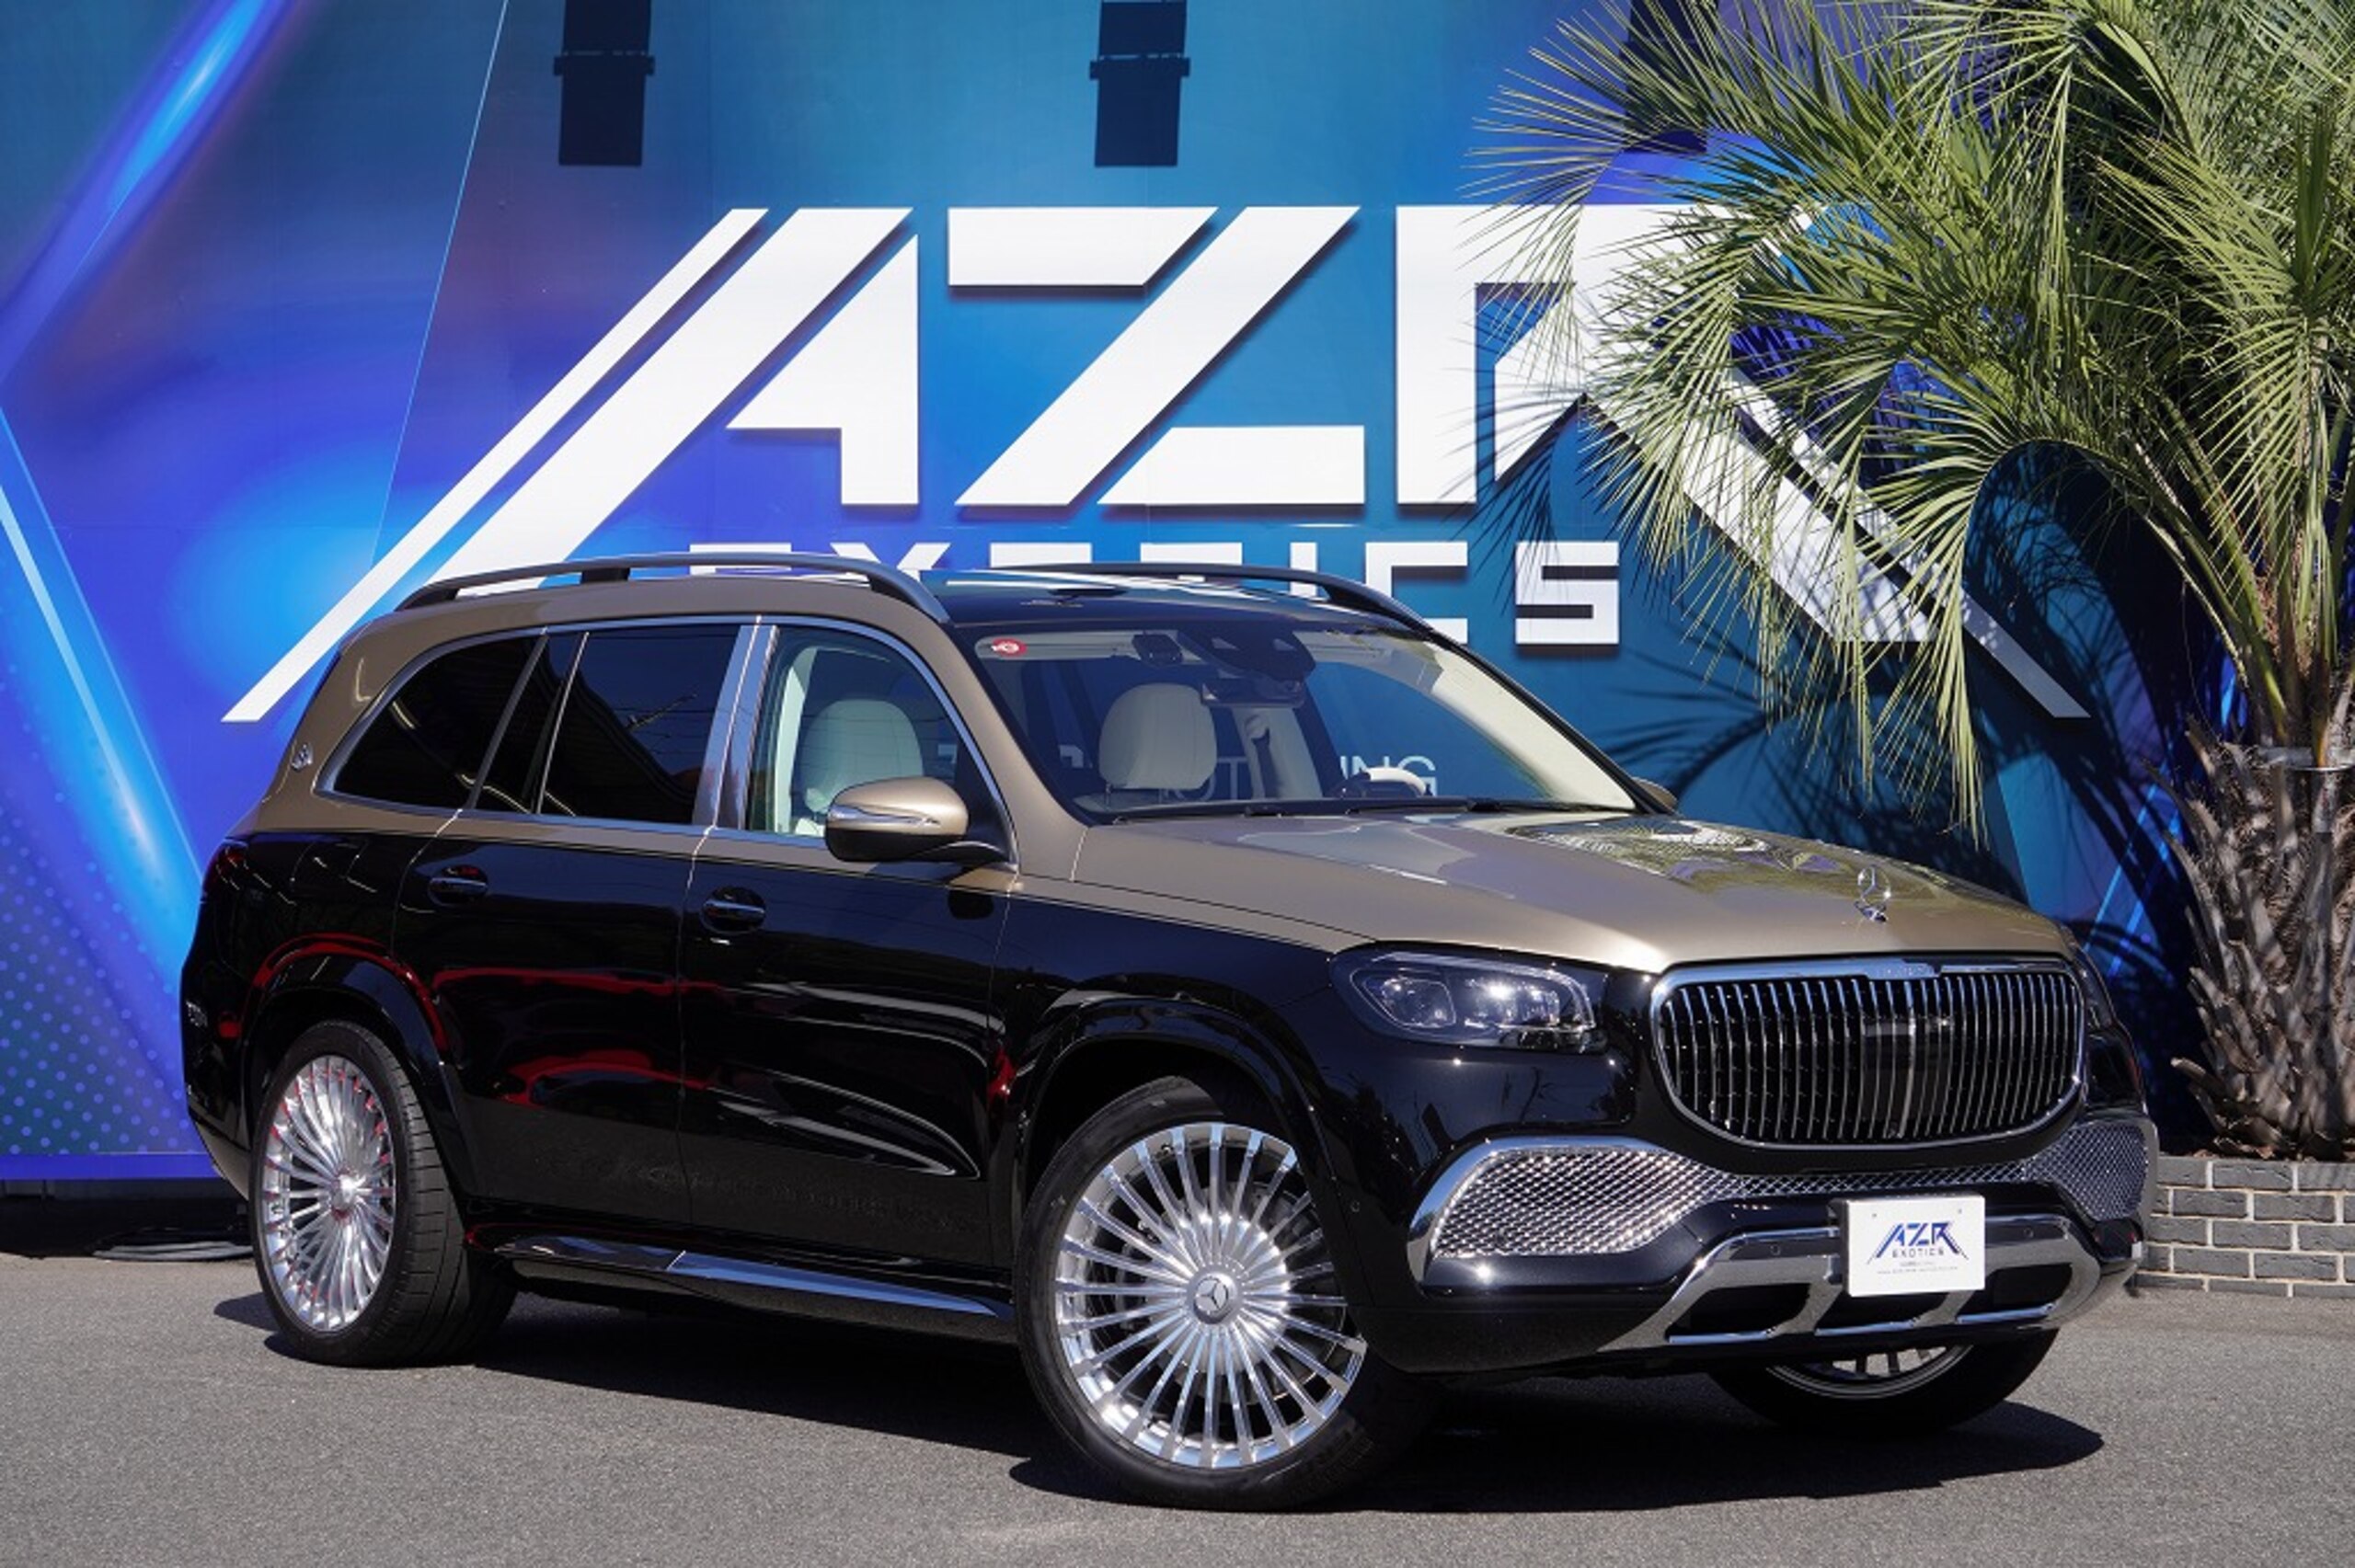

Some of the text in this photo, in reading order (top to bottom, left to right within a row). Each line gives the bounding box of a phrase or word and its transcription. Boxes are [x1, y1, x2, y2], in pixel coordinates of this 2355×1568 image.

[221, 205, 2090, 722] AZR
[1867, 1221, 1969, 1265] AZR
[1892, 1246, 1944, 1258] EXOTICS
